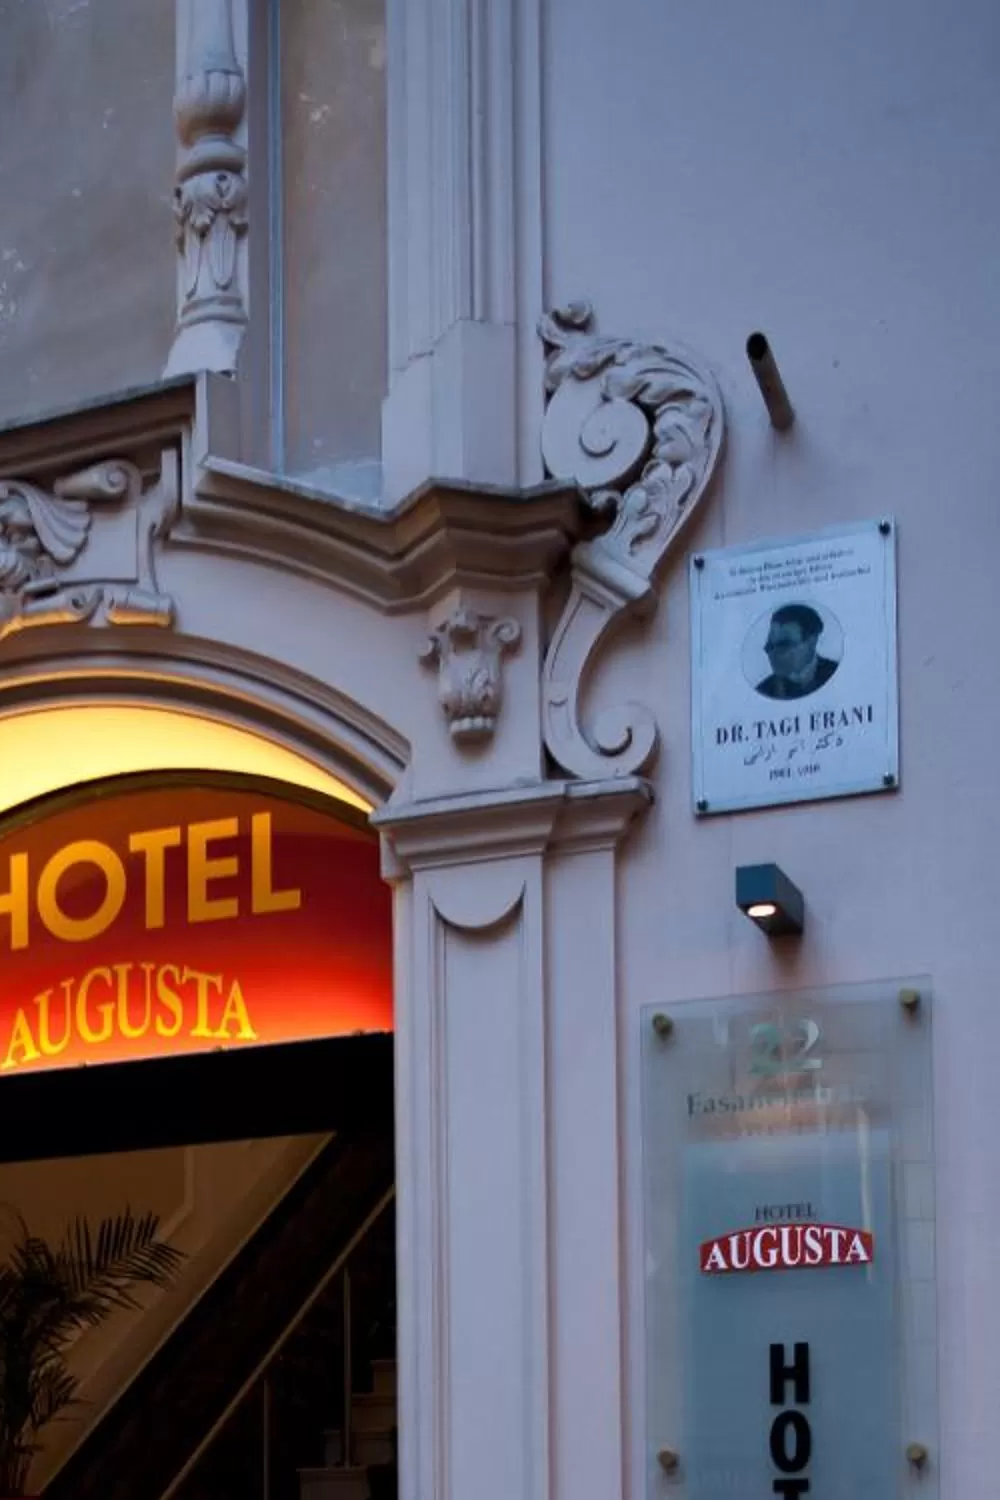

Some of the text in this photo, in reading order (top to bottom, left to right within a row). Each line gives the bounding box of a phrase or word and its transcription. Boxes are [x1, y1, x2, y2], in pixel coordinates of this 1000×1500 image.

[716, 704, 873, 745] DR. TAGI ERANI
[1, 963, 257, 1069] AUGUSTA
[754, 1202, 817, 1222] HOTEL
[703, 1226, 870, 1271] AUGUSTA
